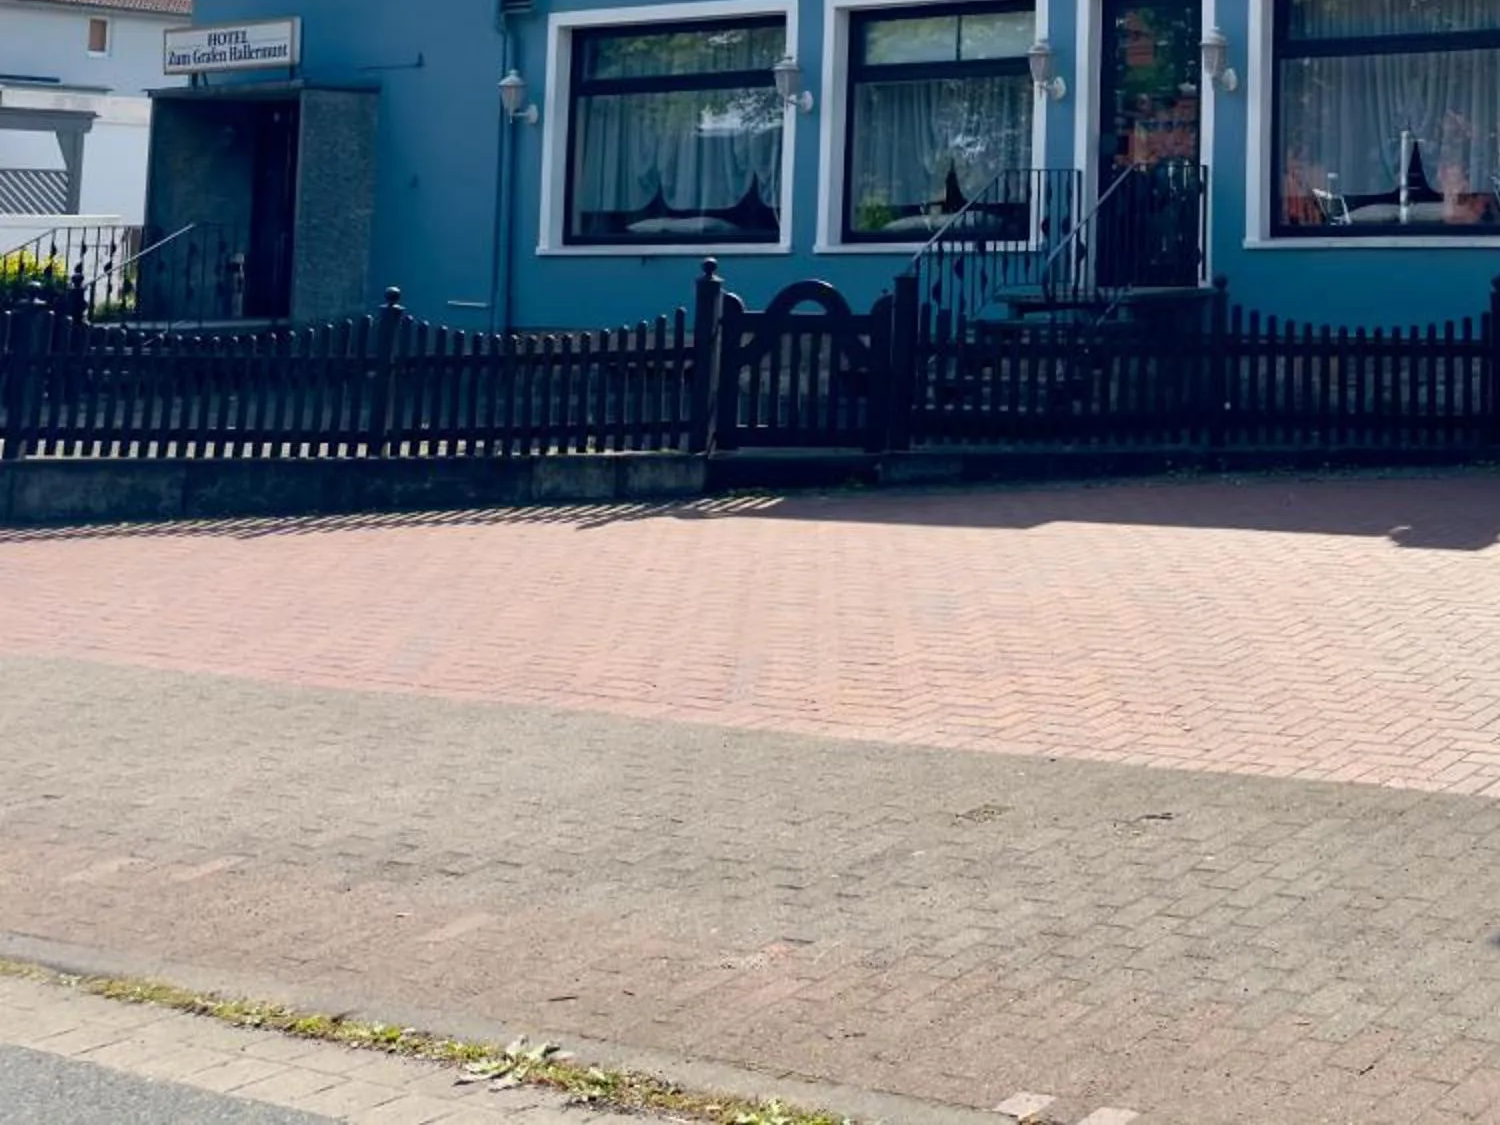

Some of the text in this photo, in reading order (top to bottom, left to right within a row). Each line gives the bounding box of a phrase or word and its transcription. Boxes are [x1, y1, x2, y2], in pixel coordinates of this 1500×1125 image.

[207, 30, 248, 47] HOTEL
[168, 43, 288, 66] Zum Grafen Hallermunt
